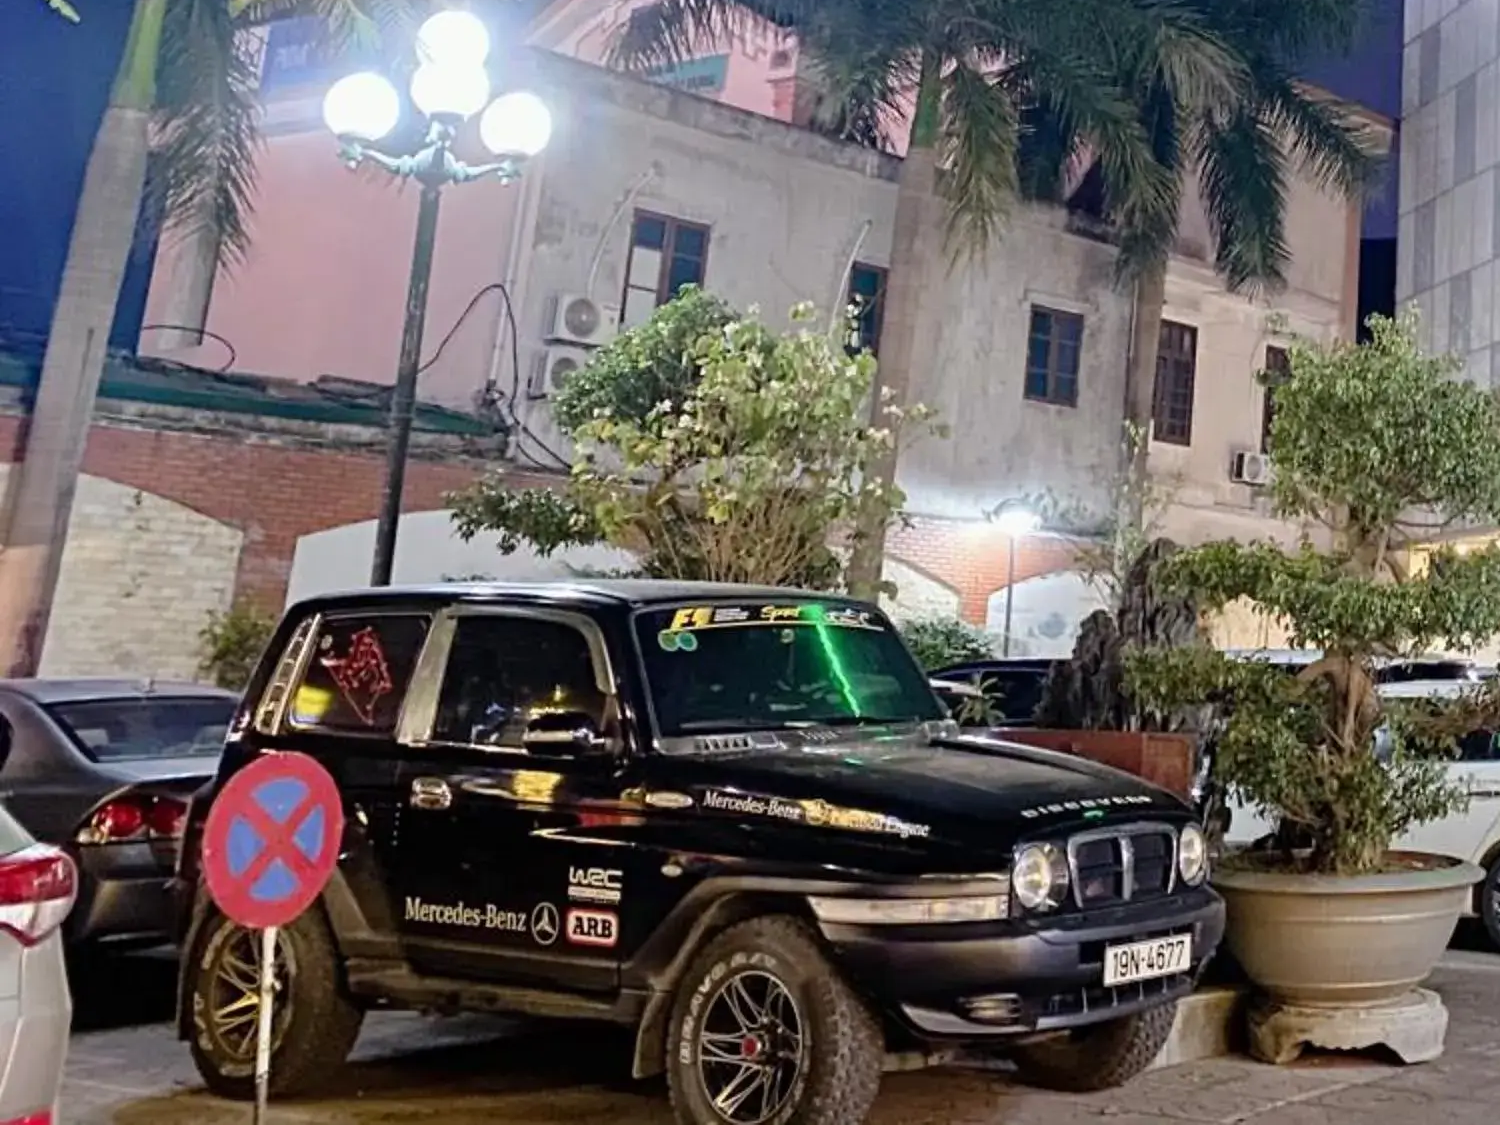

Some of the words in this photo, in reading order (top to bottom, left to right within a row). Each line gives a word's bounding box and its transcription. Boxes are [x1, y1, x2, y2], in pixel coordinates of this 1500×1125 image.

[701, 790, 801, 820] Mercedes-Benz
[568, 865, 624, 889] WRC
[404, 896, 527, 932] Mercedes-Benz
[571, 915, 614, 939] ARB
